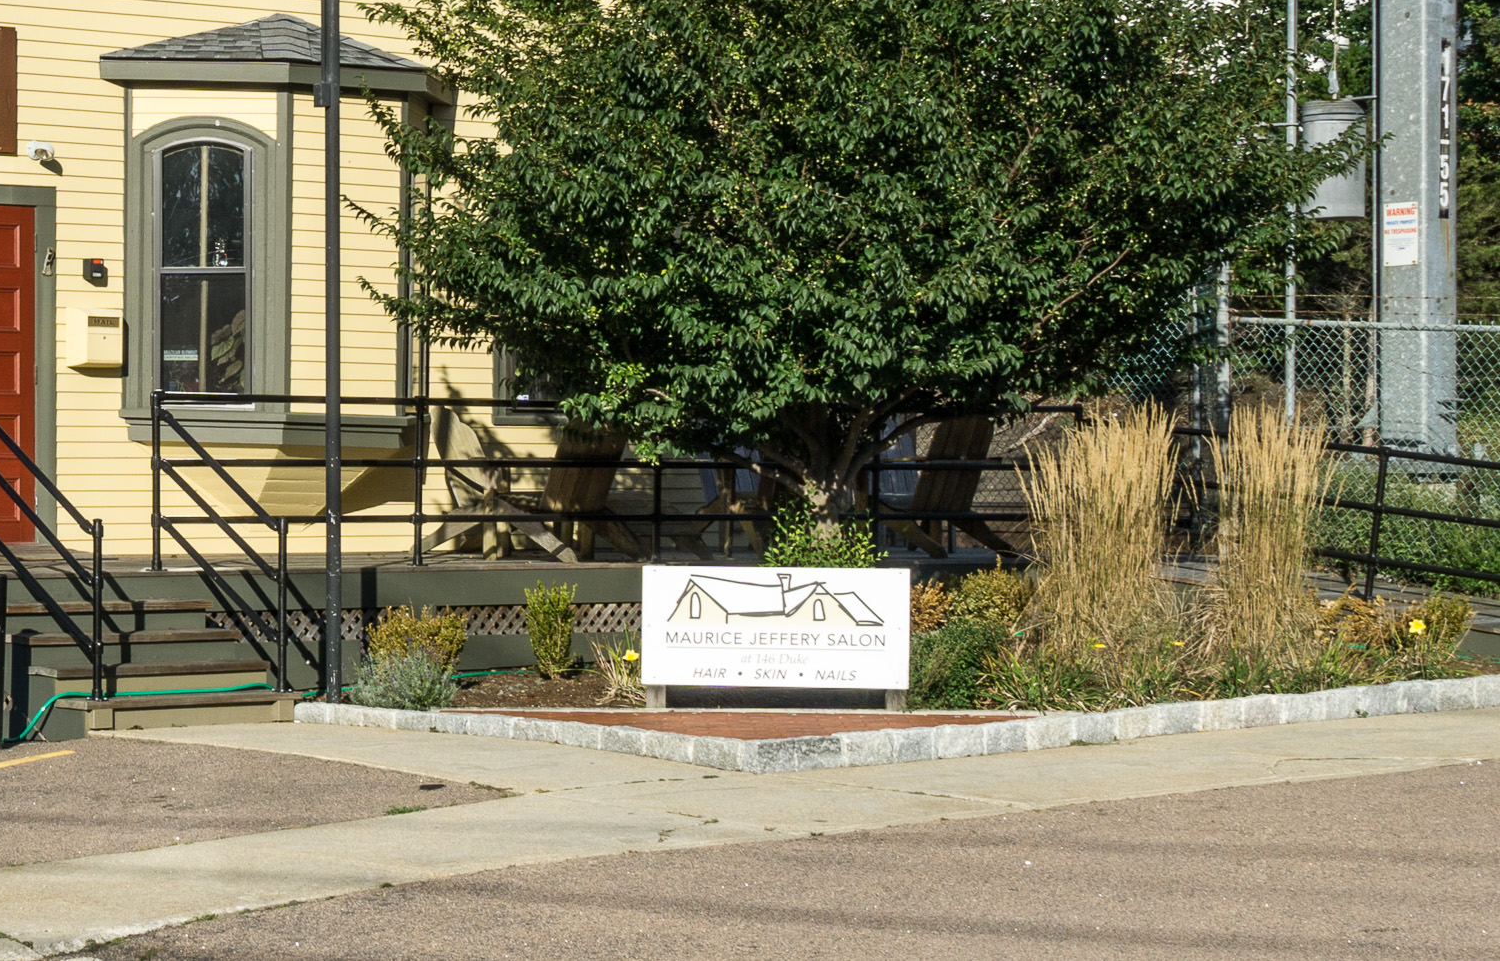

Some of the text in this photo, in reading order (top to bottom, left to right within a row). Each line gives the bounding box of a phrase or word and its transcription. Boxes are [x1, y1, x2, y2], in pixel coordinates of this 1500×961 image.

[1387, 208, 1415, 216] WARNING
[666, 631, 886, 647] MAURICE JEFFERY SALON
[741, 654, 809, 665] at 146 Duke
[693, 668, 857, 681] HAIR SKIN NAILS
